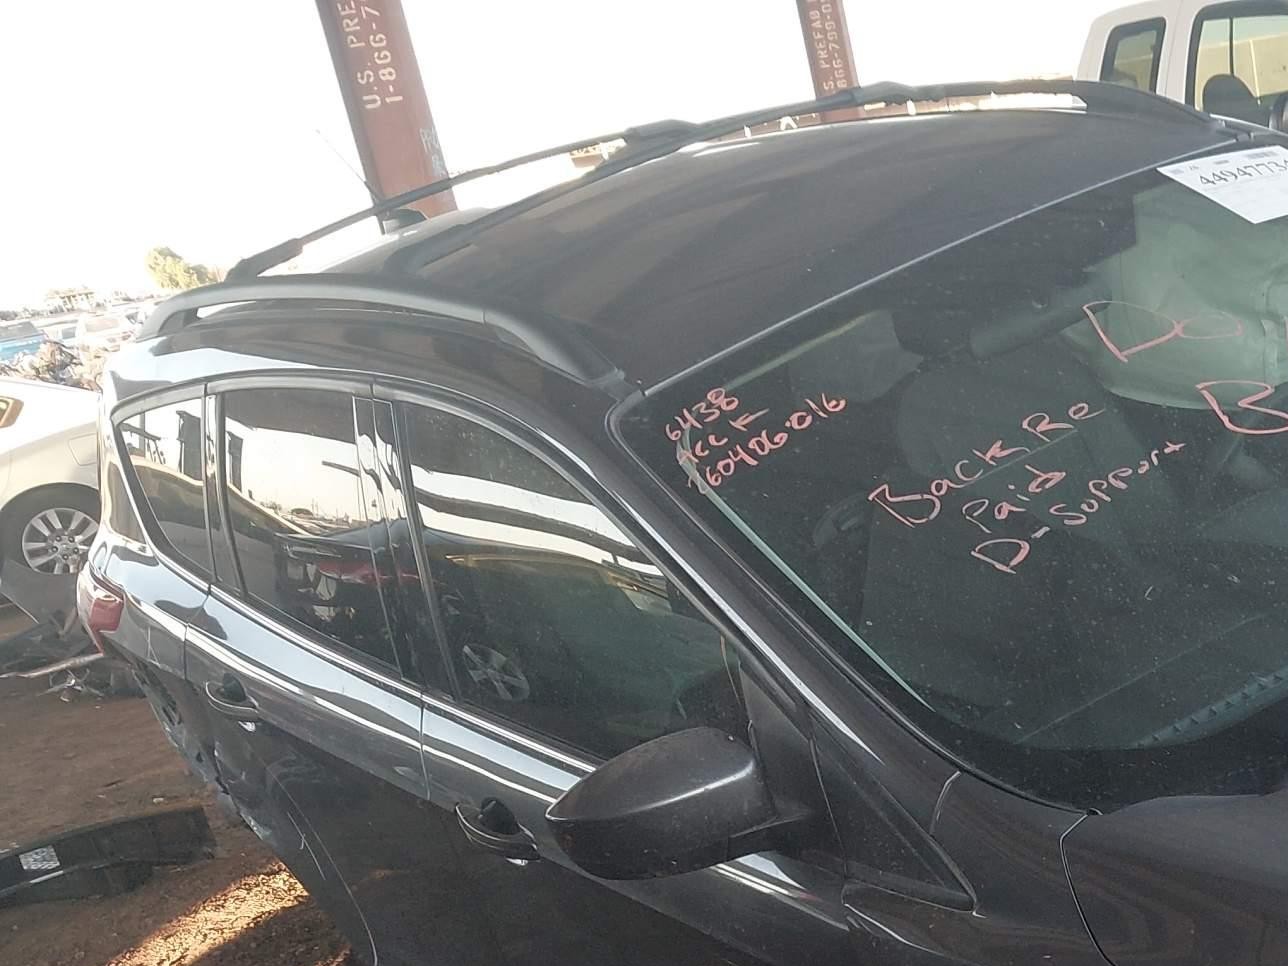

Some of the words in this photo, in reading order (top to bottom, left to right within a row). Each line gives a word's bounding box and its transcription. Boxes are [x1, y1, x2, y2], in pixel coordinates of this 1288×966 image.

[360, 0, 403, 103] 1-866-7
[809, 9, 831, 69] PREFAB
[357, 61, 382, 109] U.S.
[665, 387, 739, 441] 6438
